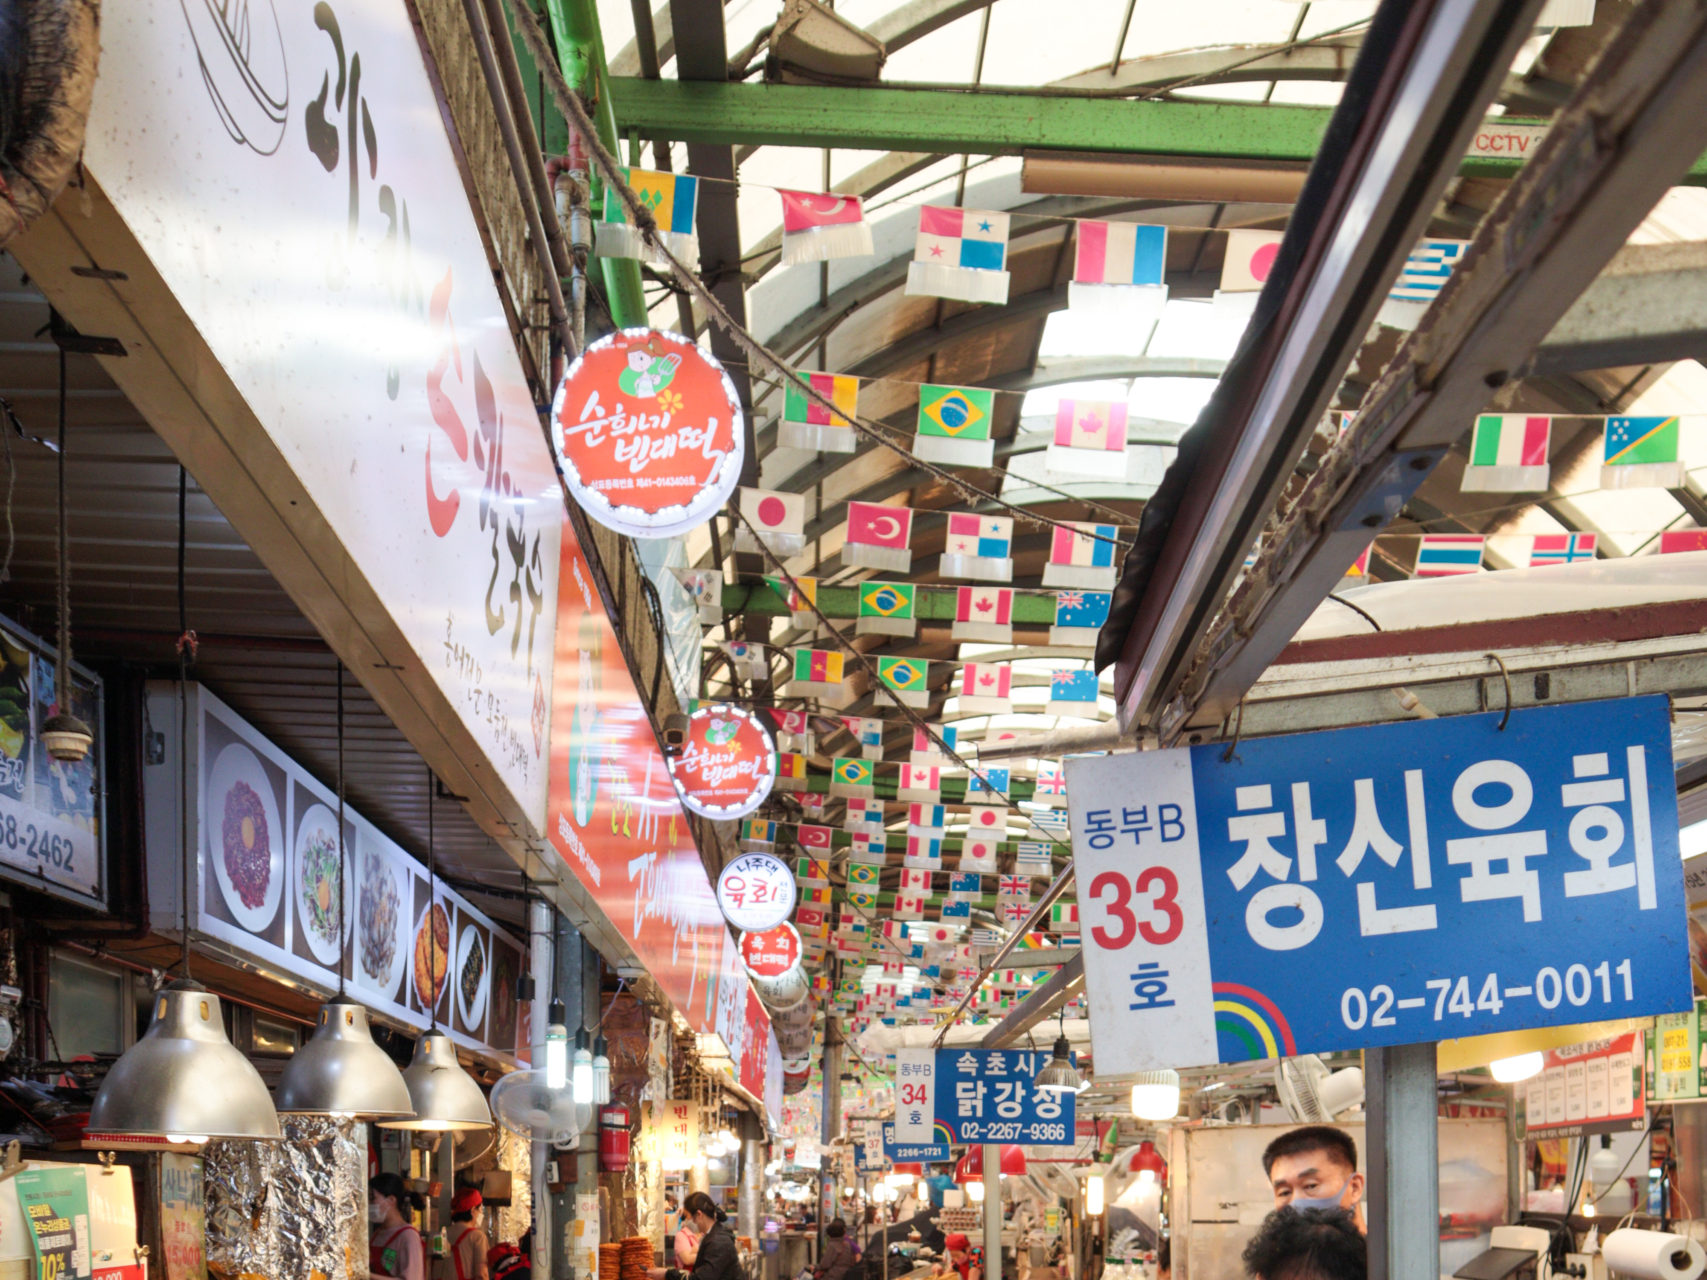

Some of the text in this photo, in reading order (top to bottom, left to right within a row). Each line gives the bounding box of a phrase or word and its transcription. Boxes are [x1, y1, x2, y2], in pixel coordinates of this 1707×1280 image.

[1475, 133, 1529, 152] CCTV
[614, 417, 726, 487] 빈대떡
[702, 755, 769, 793] 빈대떡
[1084, 803, 1185, 850] 동부B
[1226, 745, 1658, 951] 창신육회
[724, 875, 778, 909] 육회
[1089, 866, 1184, 950] 33
[1129, 962, 1176, 1011] 호
[1342, 958, 1634, 1031] 02-744-0011
[900, 1063, 931, 1077] 동부B
[956, 1052, 1052, 1078] 속초시
[902, 1084, 927, 1105] 34
[955, 1081, 1062, 1119] 닭강정
[908, 1110, 923, 1125] 호
[961, 1122, 1065, 1141] 02-2267-9366
[868, 1140, 880, 1149] 37
